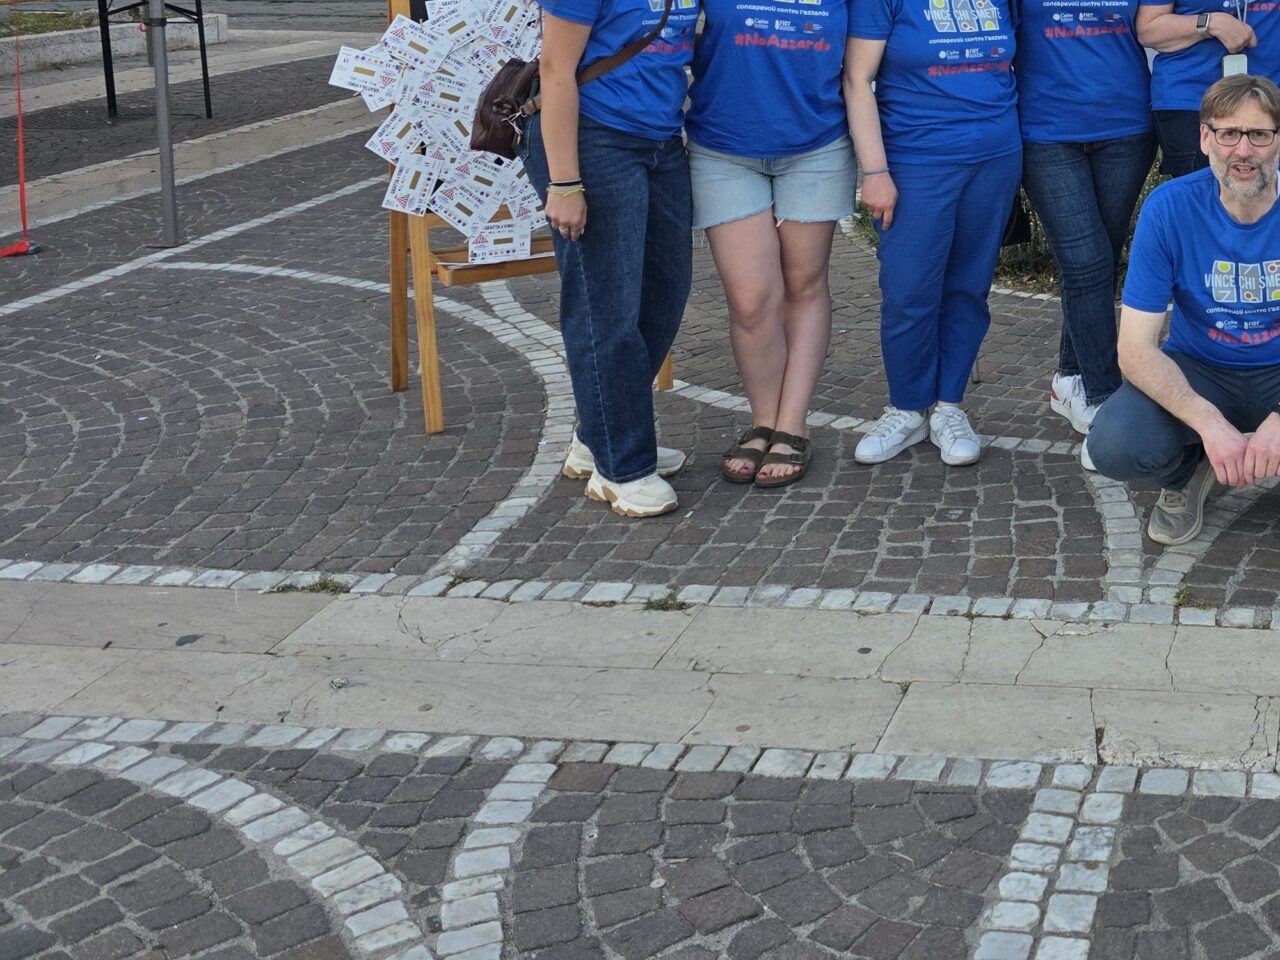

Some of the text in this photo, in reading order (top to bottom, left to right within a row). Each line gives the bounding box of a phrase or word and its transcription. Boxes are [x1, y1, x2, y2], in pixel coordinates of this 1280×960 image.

[736, 4, 776, 12] consapevoli
[777, 7, 798, 15] contro
[924, 7, 1002, 21] VINCE CHI SMETTE
[431, 15, 446, 25] GRATTA
[409, 24, 425, 34] GRATTA
[735, 32, 831, 51] #NoAzzardo
[460, 185, 473, 197] GRATTA
[1205, 273, 1235, 287] VINCE
[1239, 275, 1255, 290] CHI
